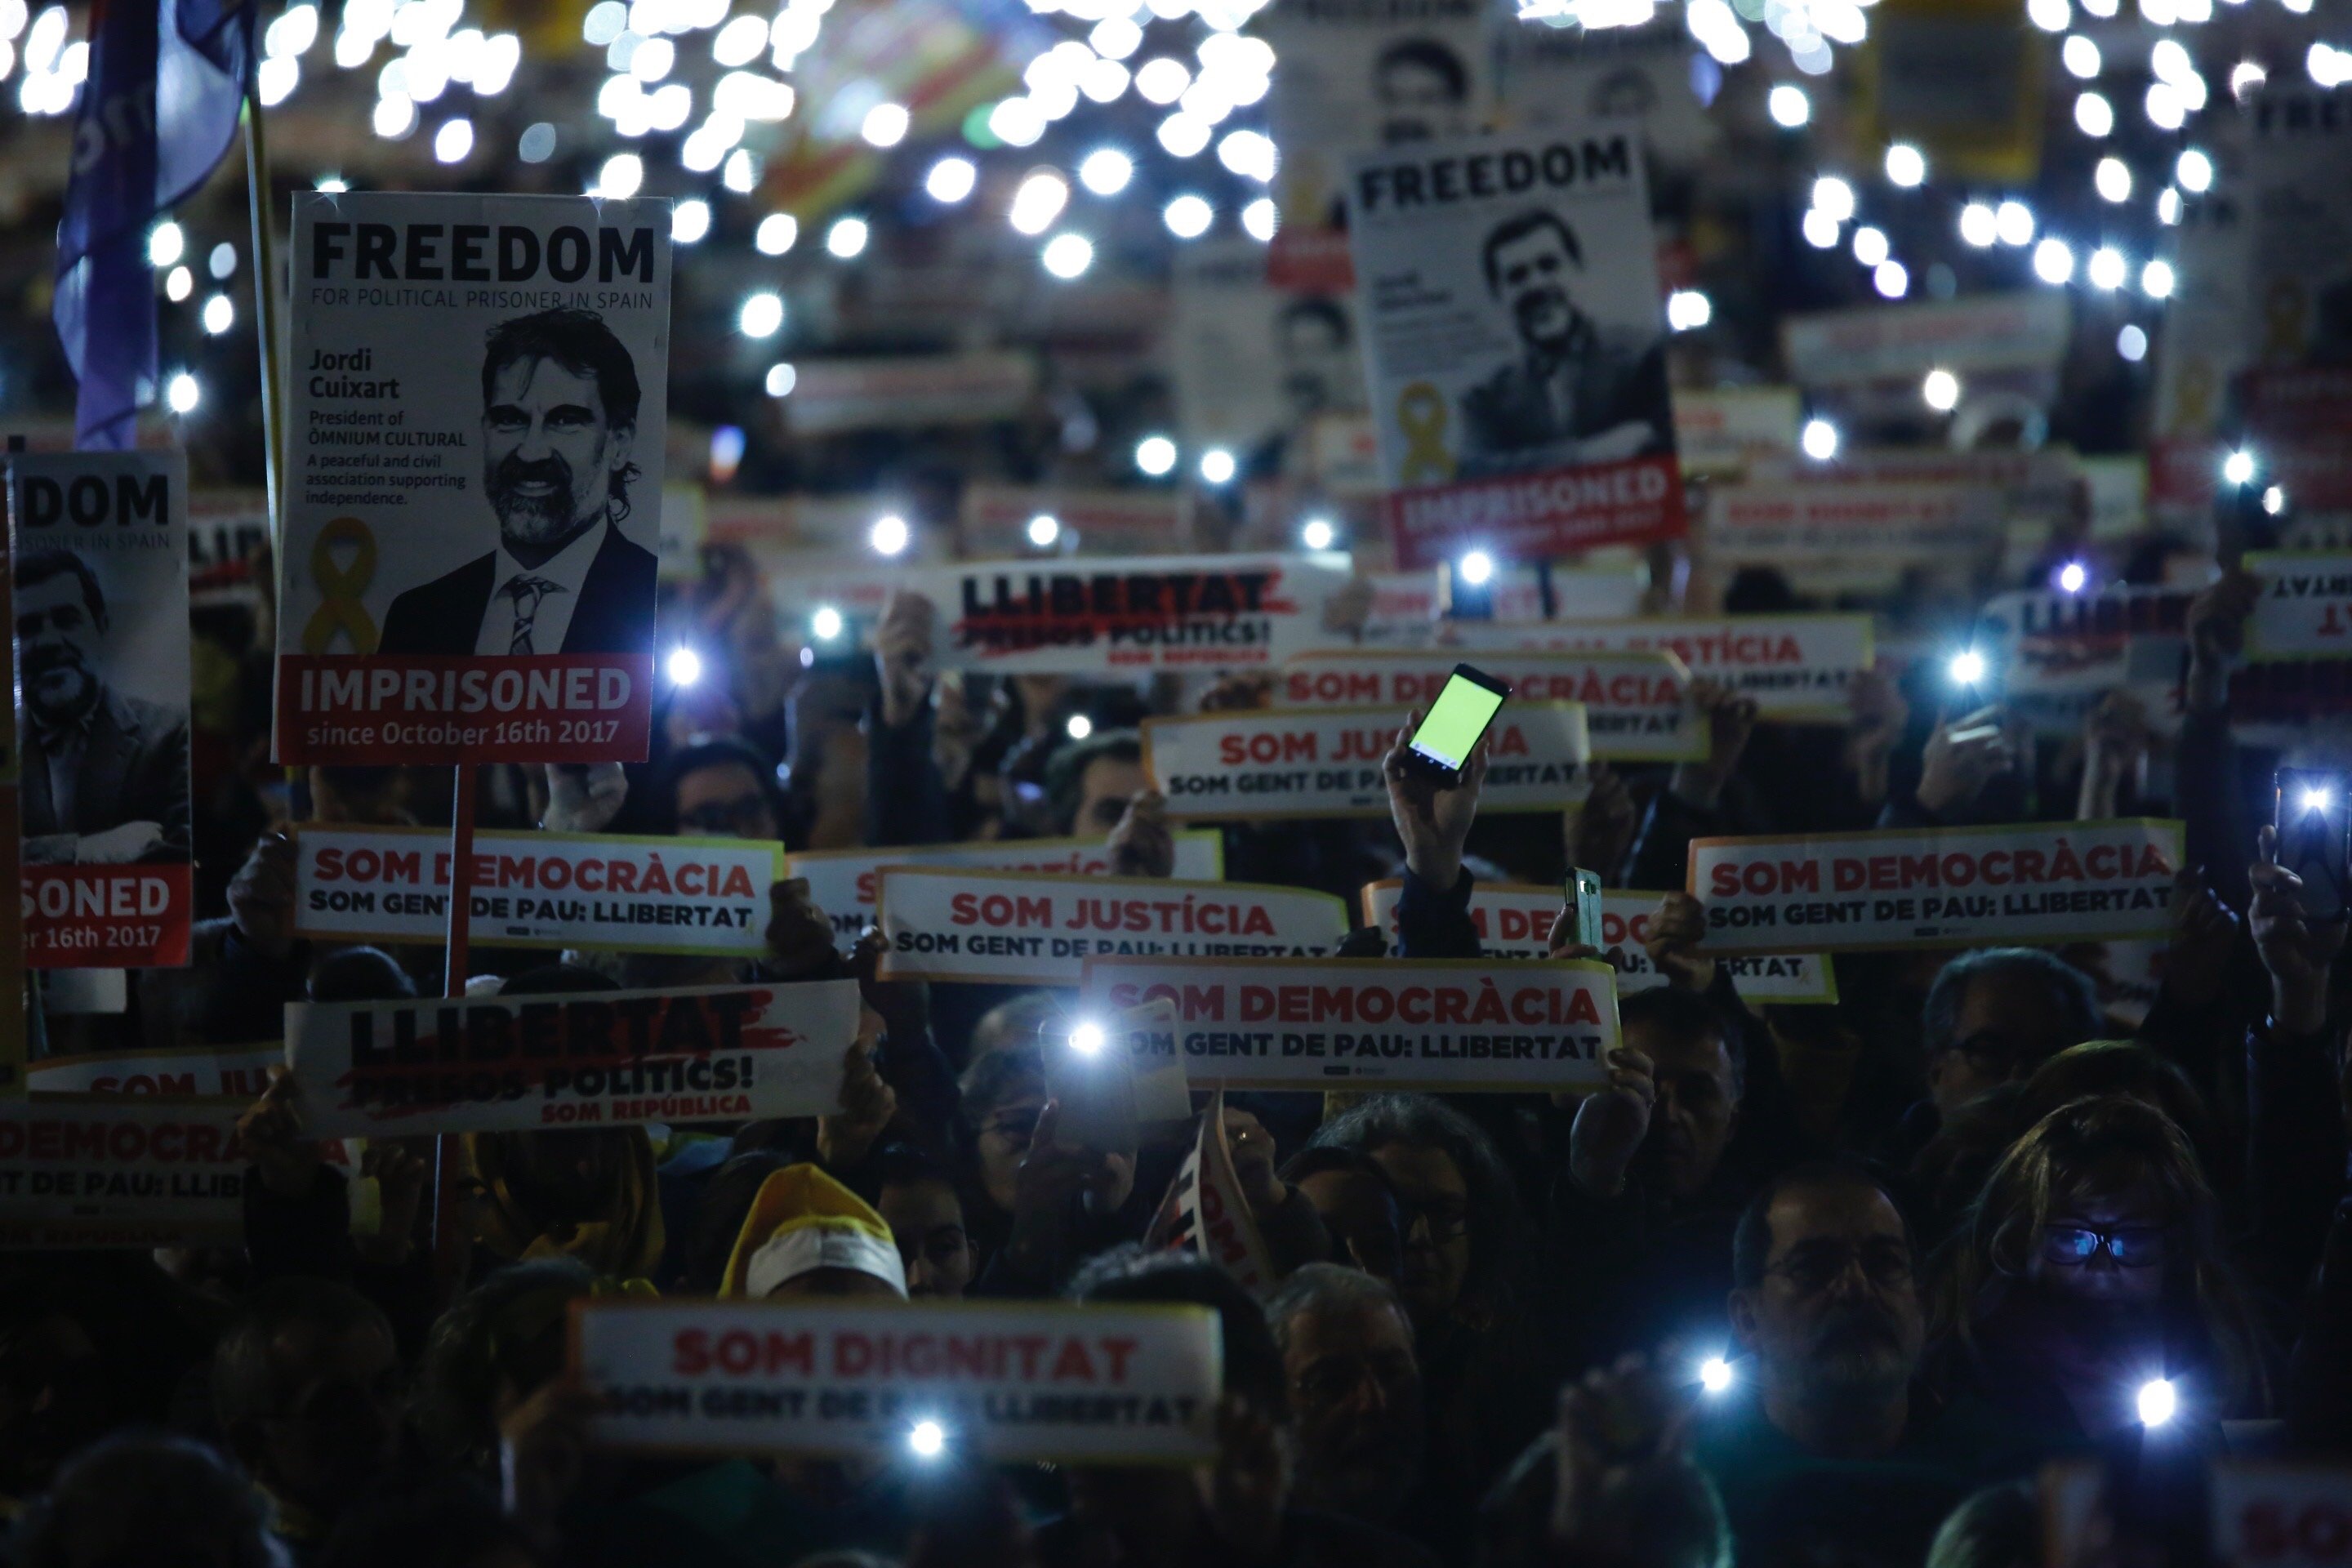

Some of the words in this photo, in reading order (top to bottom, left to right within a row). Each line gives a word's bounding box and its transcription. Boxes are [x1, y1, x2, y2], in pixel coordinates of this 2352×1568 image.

[1360, 136, 1628, 211] FREEDOM
[313, 222, 654, 283] FREEDOM
[312, 288, 349, 305] FOR
[358, 288, 457, 308] POLITICAL
[467, 290, 560, 309] PRISONER
[569, 292, 590, 309] IN
[596, 292, 653, 310] SPAIN
[309, 349, 372, 374] Jordi
[310, 376, 399, 399] Cuixart
[309, 411, 383, 426] President
[387, 410, 404, 426] of
[308, 427, 381, 447] ÒMNIUM
[385, 431, 466, 448] CULTURAL
[307, 455, 317, 468] A
[321, 453, 380, 472] peaceful
[384, 454, 408, 470] and
[413, 454, 442, 470] civil
[305, 471, 385, 488] association
[389, 473, 466, 491] supporting
[305, 491, 408, 508] independence.
[301, 666, 631, 714] IMPRISONED
[1287, 674, 1383, 702] SOM
[1392, 667, 1679, 706] DECRÀCIA
[307, 720, 376, 746] since
[381, 719, 489, 746] October
[494, 719, 550, 746] 16th
[558, 719, 621, 746] 2017
[1220, 732, 1317, 764] SOM
[1331, 724, 1530, 760] JUSIA
[1169, 773, 1232, 795] SOM
[1238, 770, 1308, 792] GENT
[1317, 768, 1354, 790] DE
[314, 849, 421, 884] SOM
[1709, 858, 1821, 898] SOM
[1833, 837, 2173, 893] DEMOCRÀCIA
[310, 889, 381, 912] SOM
[470, 897, 509, 918] DE
[517, 898, 587, 924] PAU:
[593, 903, 753, 929] LLIBERTAT
[951, 893, 1052, 929] SOM
[1065, 893, 1276, 936] JUSTÍCIA
[1709, 903, 1776, 929] SOM
[1786, 901, 1867, 926] GENT
[1874, 899, 1916, 921] DE
[1922, 897, 1998, 920] PAU:
[2004, 885, 2173, 915] LLIBERTAT
[47, 925, 99, 948] 16th
[106, 924, 162, 947] 2017
[896, 932, 960, 954] SOM
[967, 934, 1046, 958] GENT
[1051, 938, 1090, 958] DE
[1716, 957, 1802, 977] ERTAT
[1240, 977, 1602, 1027] DEMOCRÀCIA
[351, 992, 756, 1068] LLIBERTAT
[1184, 1031, 1270, 1057] GENT
[1281, 1033, 1326, 1056] DE
[1334, 1033, 1413, 1059] PAU:
[1421, 1036, 1602, 1060] LLIBERTAT
[543, 1051, 754, 1100] POLÍTICS!
[541, 1103, 601, 1123] SOM
[612, 1094, 752, 1120] REPÚBLICA
[32, 1171, 77, 1196] DE
[85, 1172, 163, 1197] PAU:
[672, 1329, 814, 1378] SOM
[834, 1333, 1139, 1384] DIGNITAT
[702, 1389, 805, 1420] GENT
